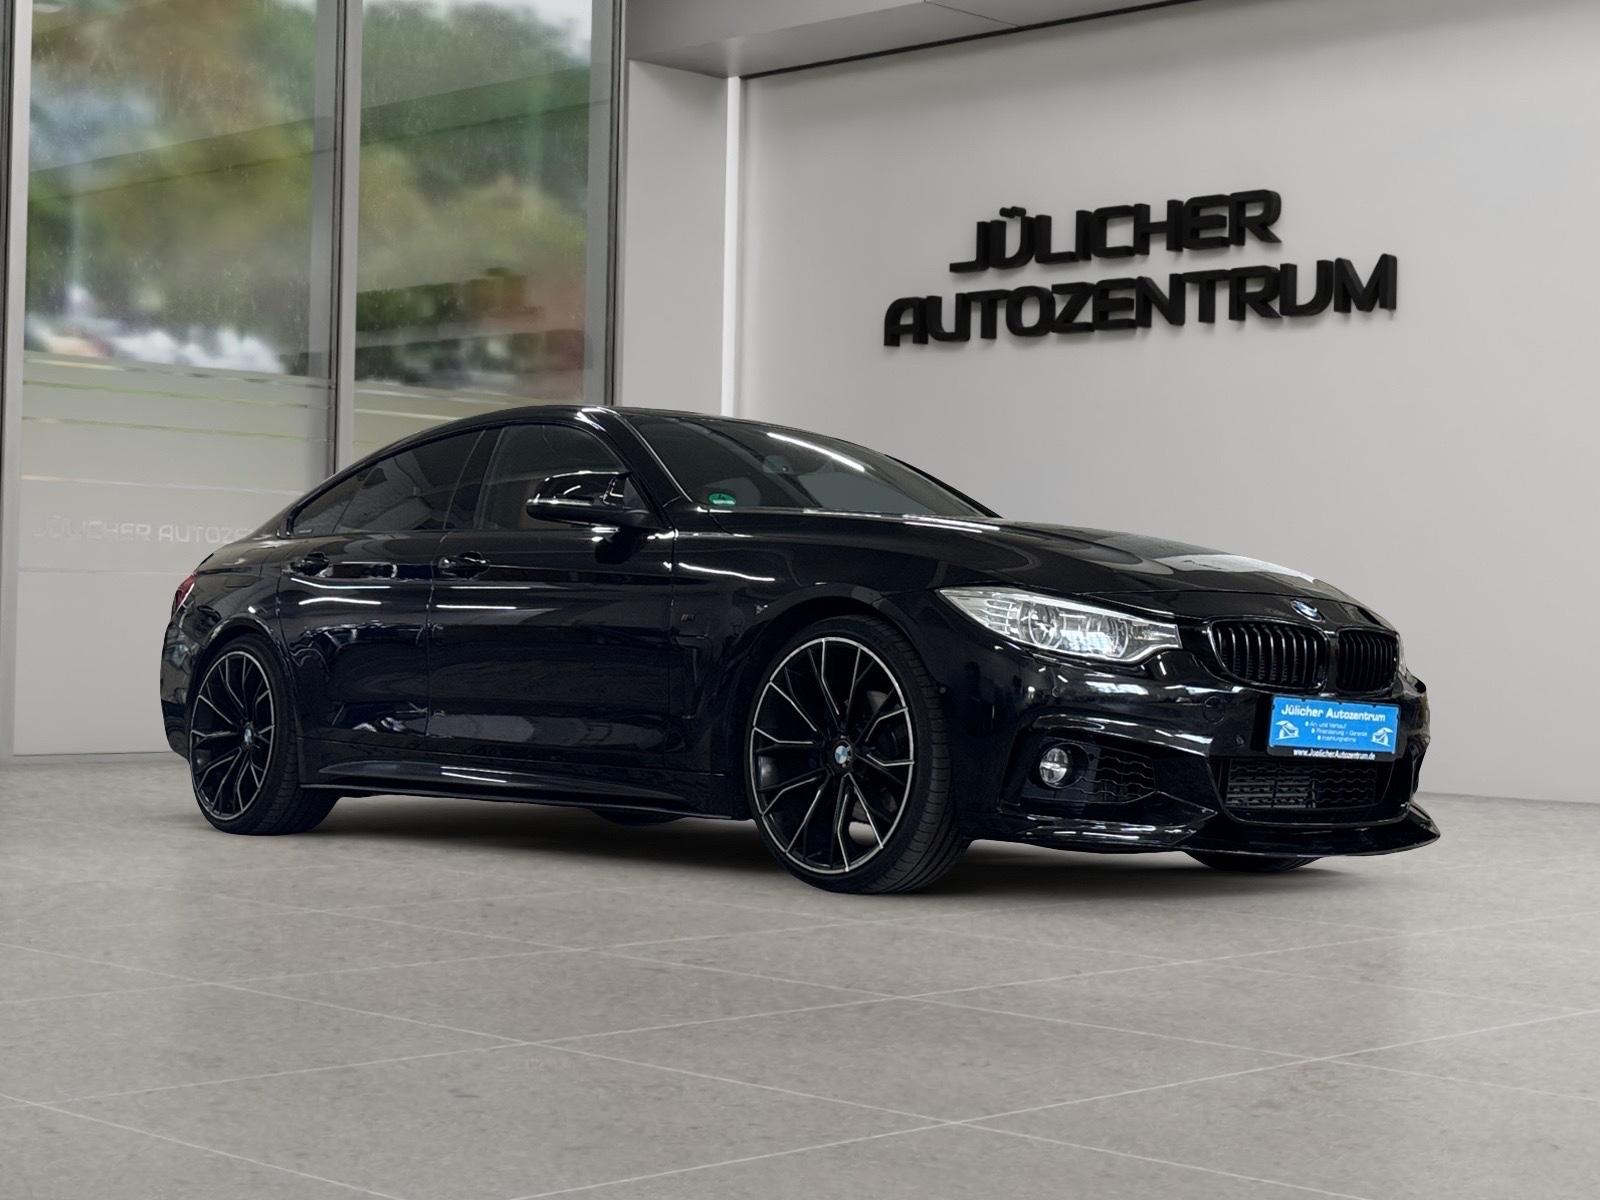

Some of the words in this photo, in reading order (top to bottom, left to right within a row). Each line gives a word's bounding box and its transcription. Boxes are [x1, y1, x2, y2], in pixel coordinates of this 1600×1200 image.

[949, 189, 1282, 273] JÜLICHER
[884, 253, 1397, 347] AUTOZENTRUM
[1281, 704, 1324, 717] Jülicher
[1326, 707, 1386, 722] Autozentrum
